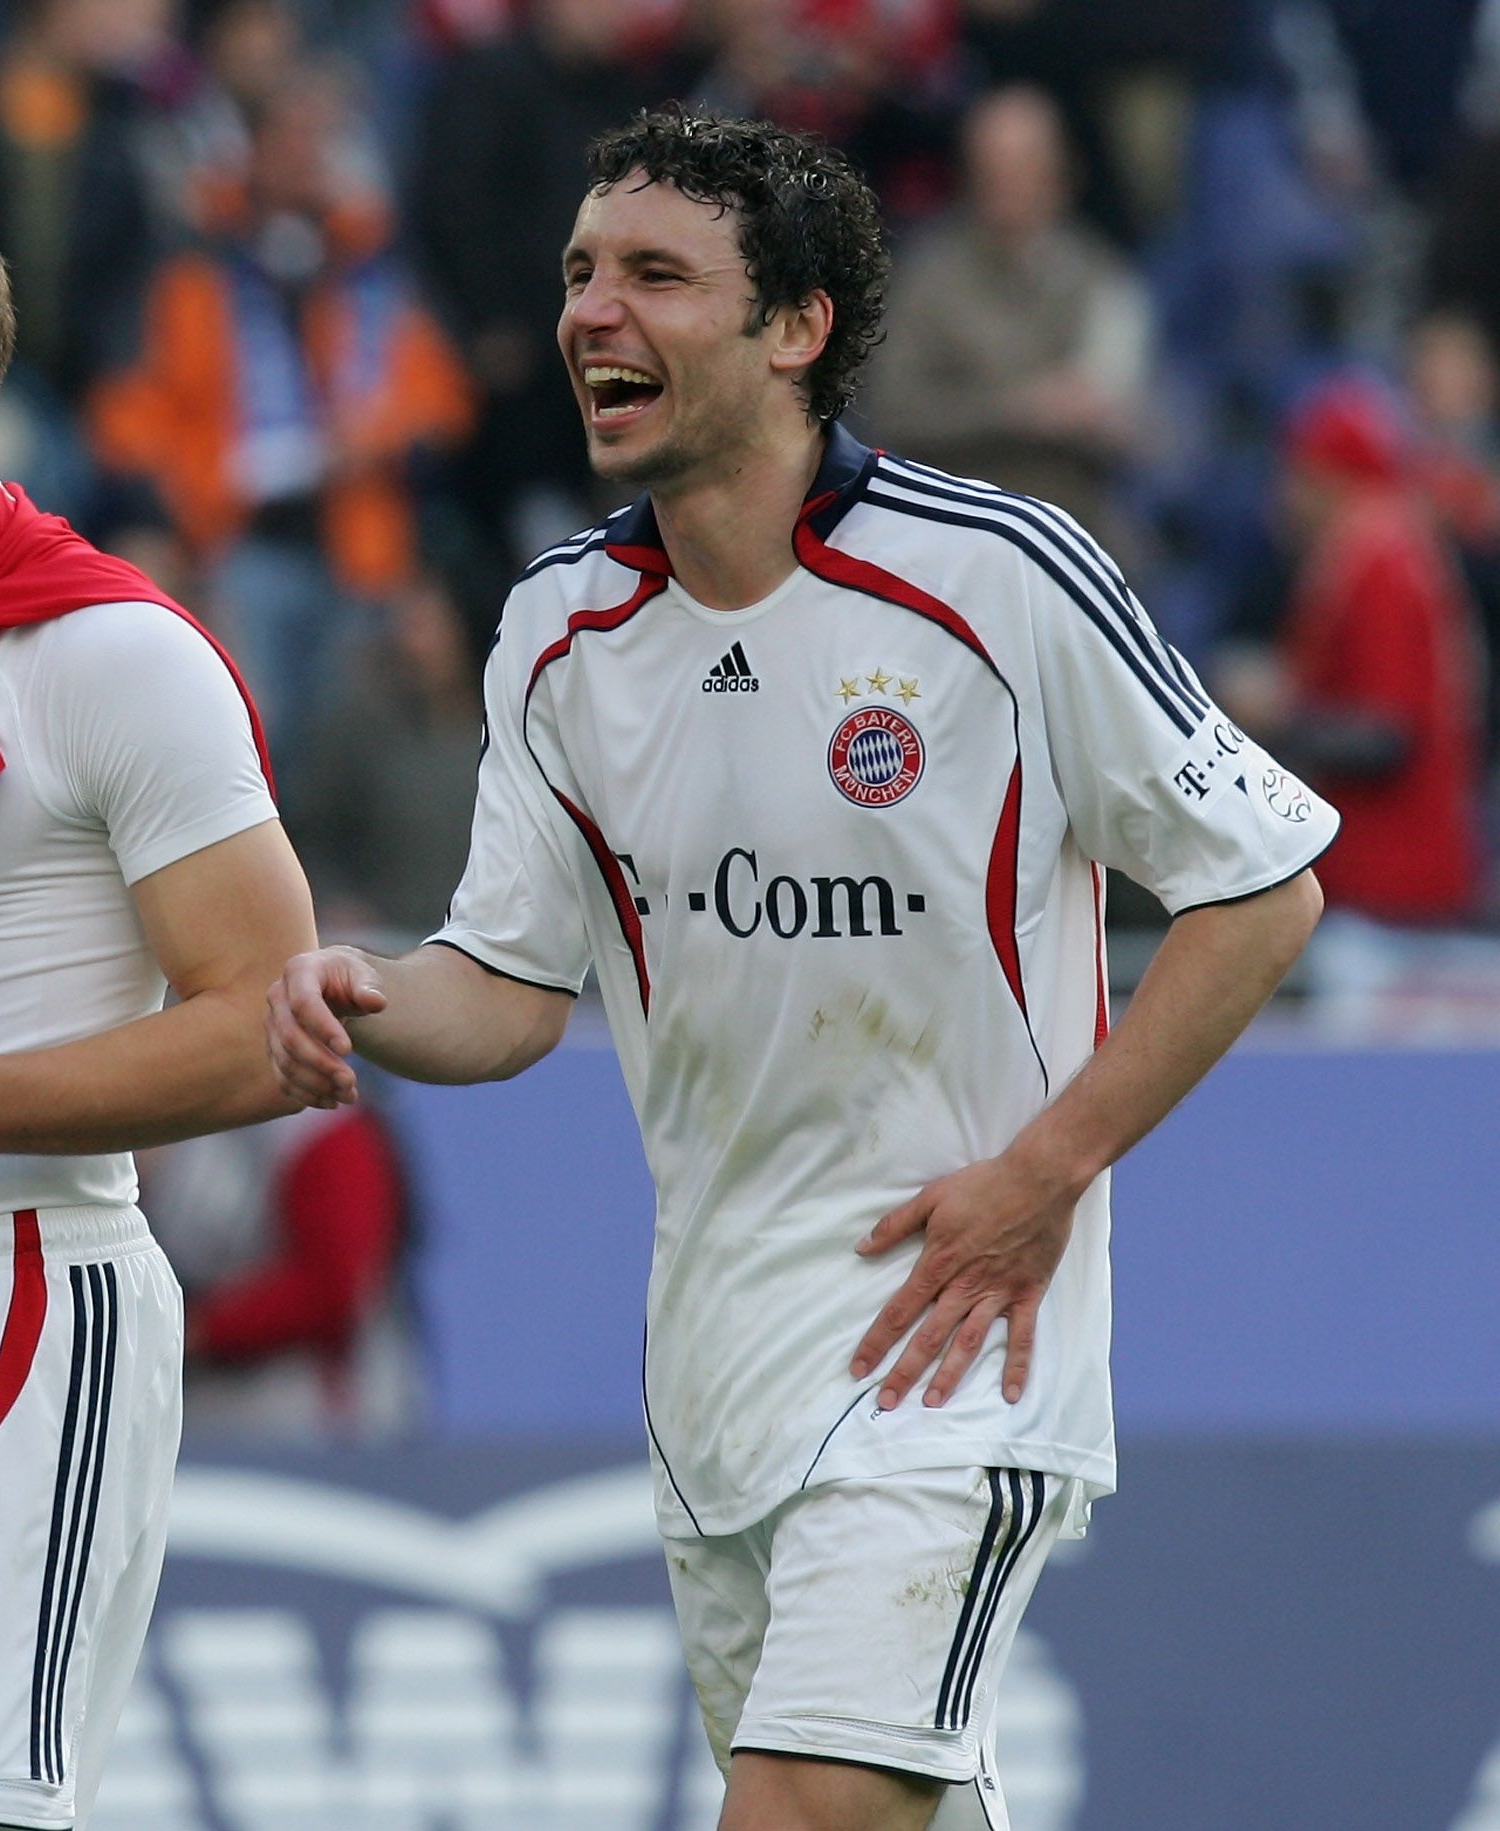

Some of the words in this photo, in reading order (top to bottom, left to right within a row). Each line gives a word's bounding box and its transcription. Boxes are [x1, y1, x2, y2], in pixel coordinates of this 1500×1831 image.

[702, 676, 760, 693] adidas
[834, 728, 853, 753] FC
[854, 712, 918, 756] BAYERN
[834, 765, 916, 802] MÜNCHEN
